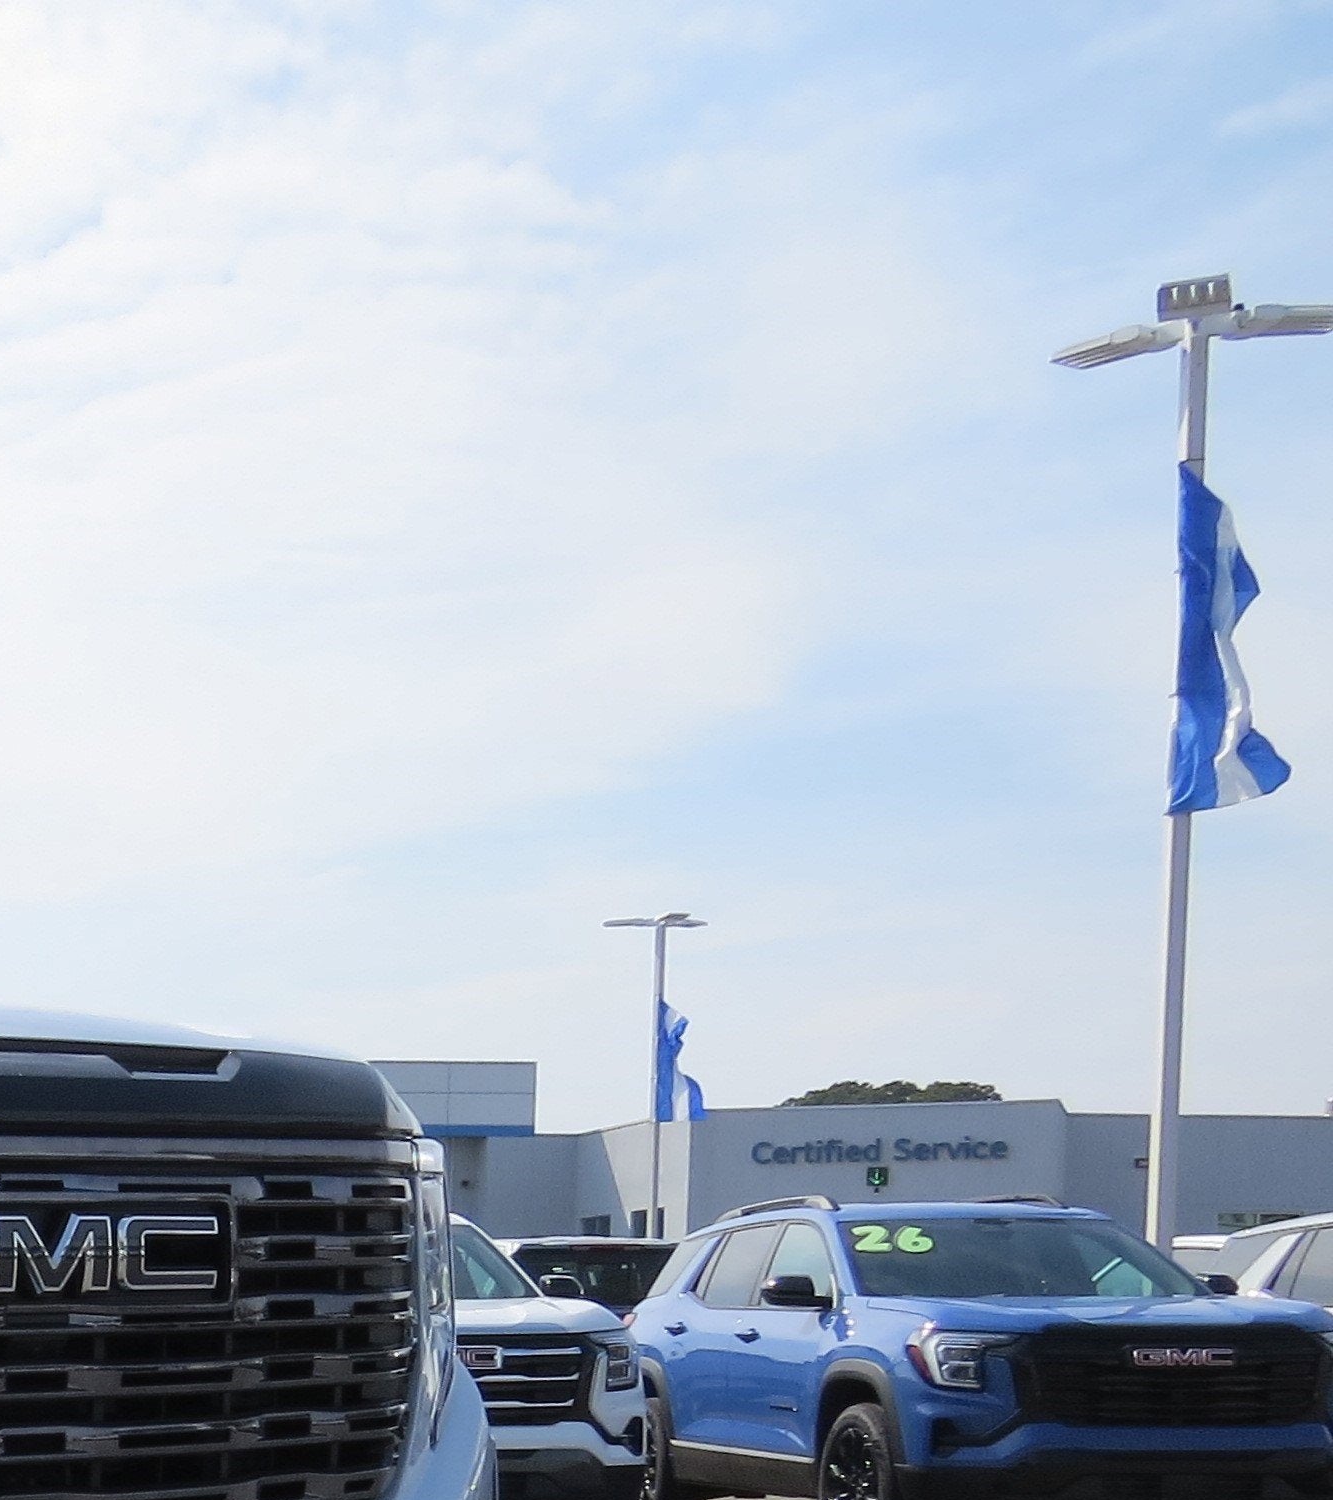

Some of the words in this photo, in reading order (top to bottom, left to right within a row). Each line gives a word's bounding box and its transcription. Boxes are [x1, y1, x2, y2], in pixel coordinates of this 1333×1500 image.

[751, 1138, 882, 1165] Certified
[893, 1135, 1009, 1161] Service
[850, 1224, 935, 1254] 26
[1133, 1348, 1234, 1367] GMC
